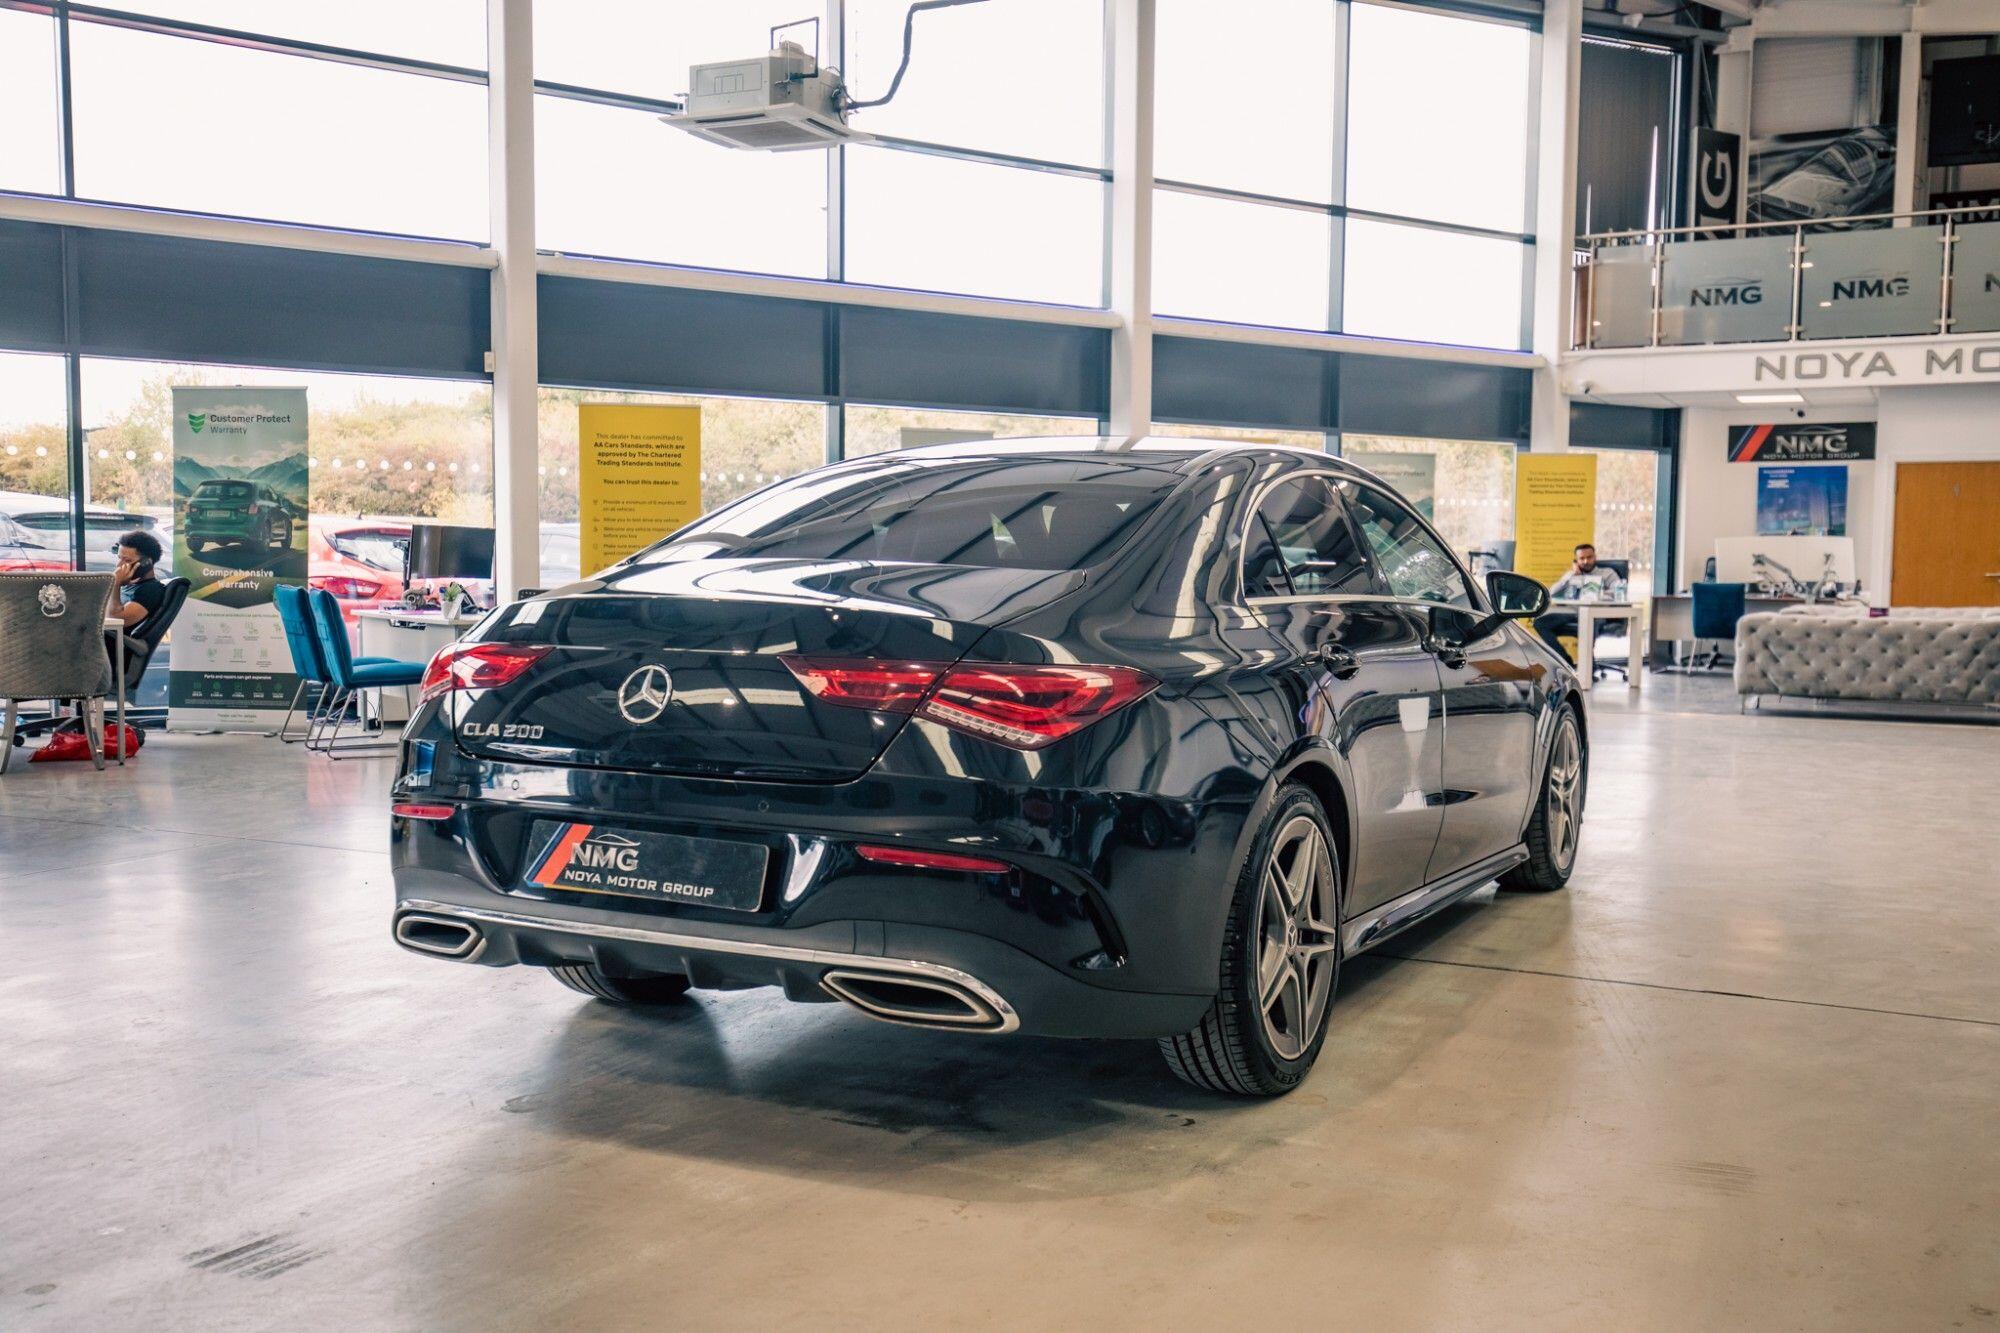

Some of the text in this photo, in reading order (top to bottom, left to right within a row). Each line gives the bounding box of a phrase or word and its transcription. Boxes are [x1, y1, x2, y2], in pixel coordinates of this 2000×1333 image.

[1690, 286, 1762, 307] NMG
[1833, 277, 1910, 300] NMG
[1755, 351, 1897, 382] NOYA
[210, 414, 291, 423] Customer Protect
[210, 426, 247, 435] Warranty
[1775, 434, 1848, 453] NMG
[597, 459, 620, 467] Trading
[202, 567, 274, 578] Comprehensive
[218, 580, 260, 590] Warranty
[463, 722, 544, 739] CLA 200
[568, 842, 640, 872] NMG
[564, 870, 715, 898] NOYA MOTOR GROUP
